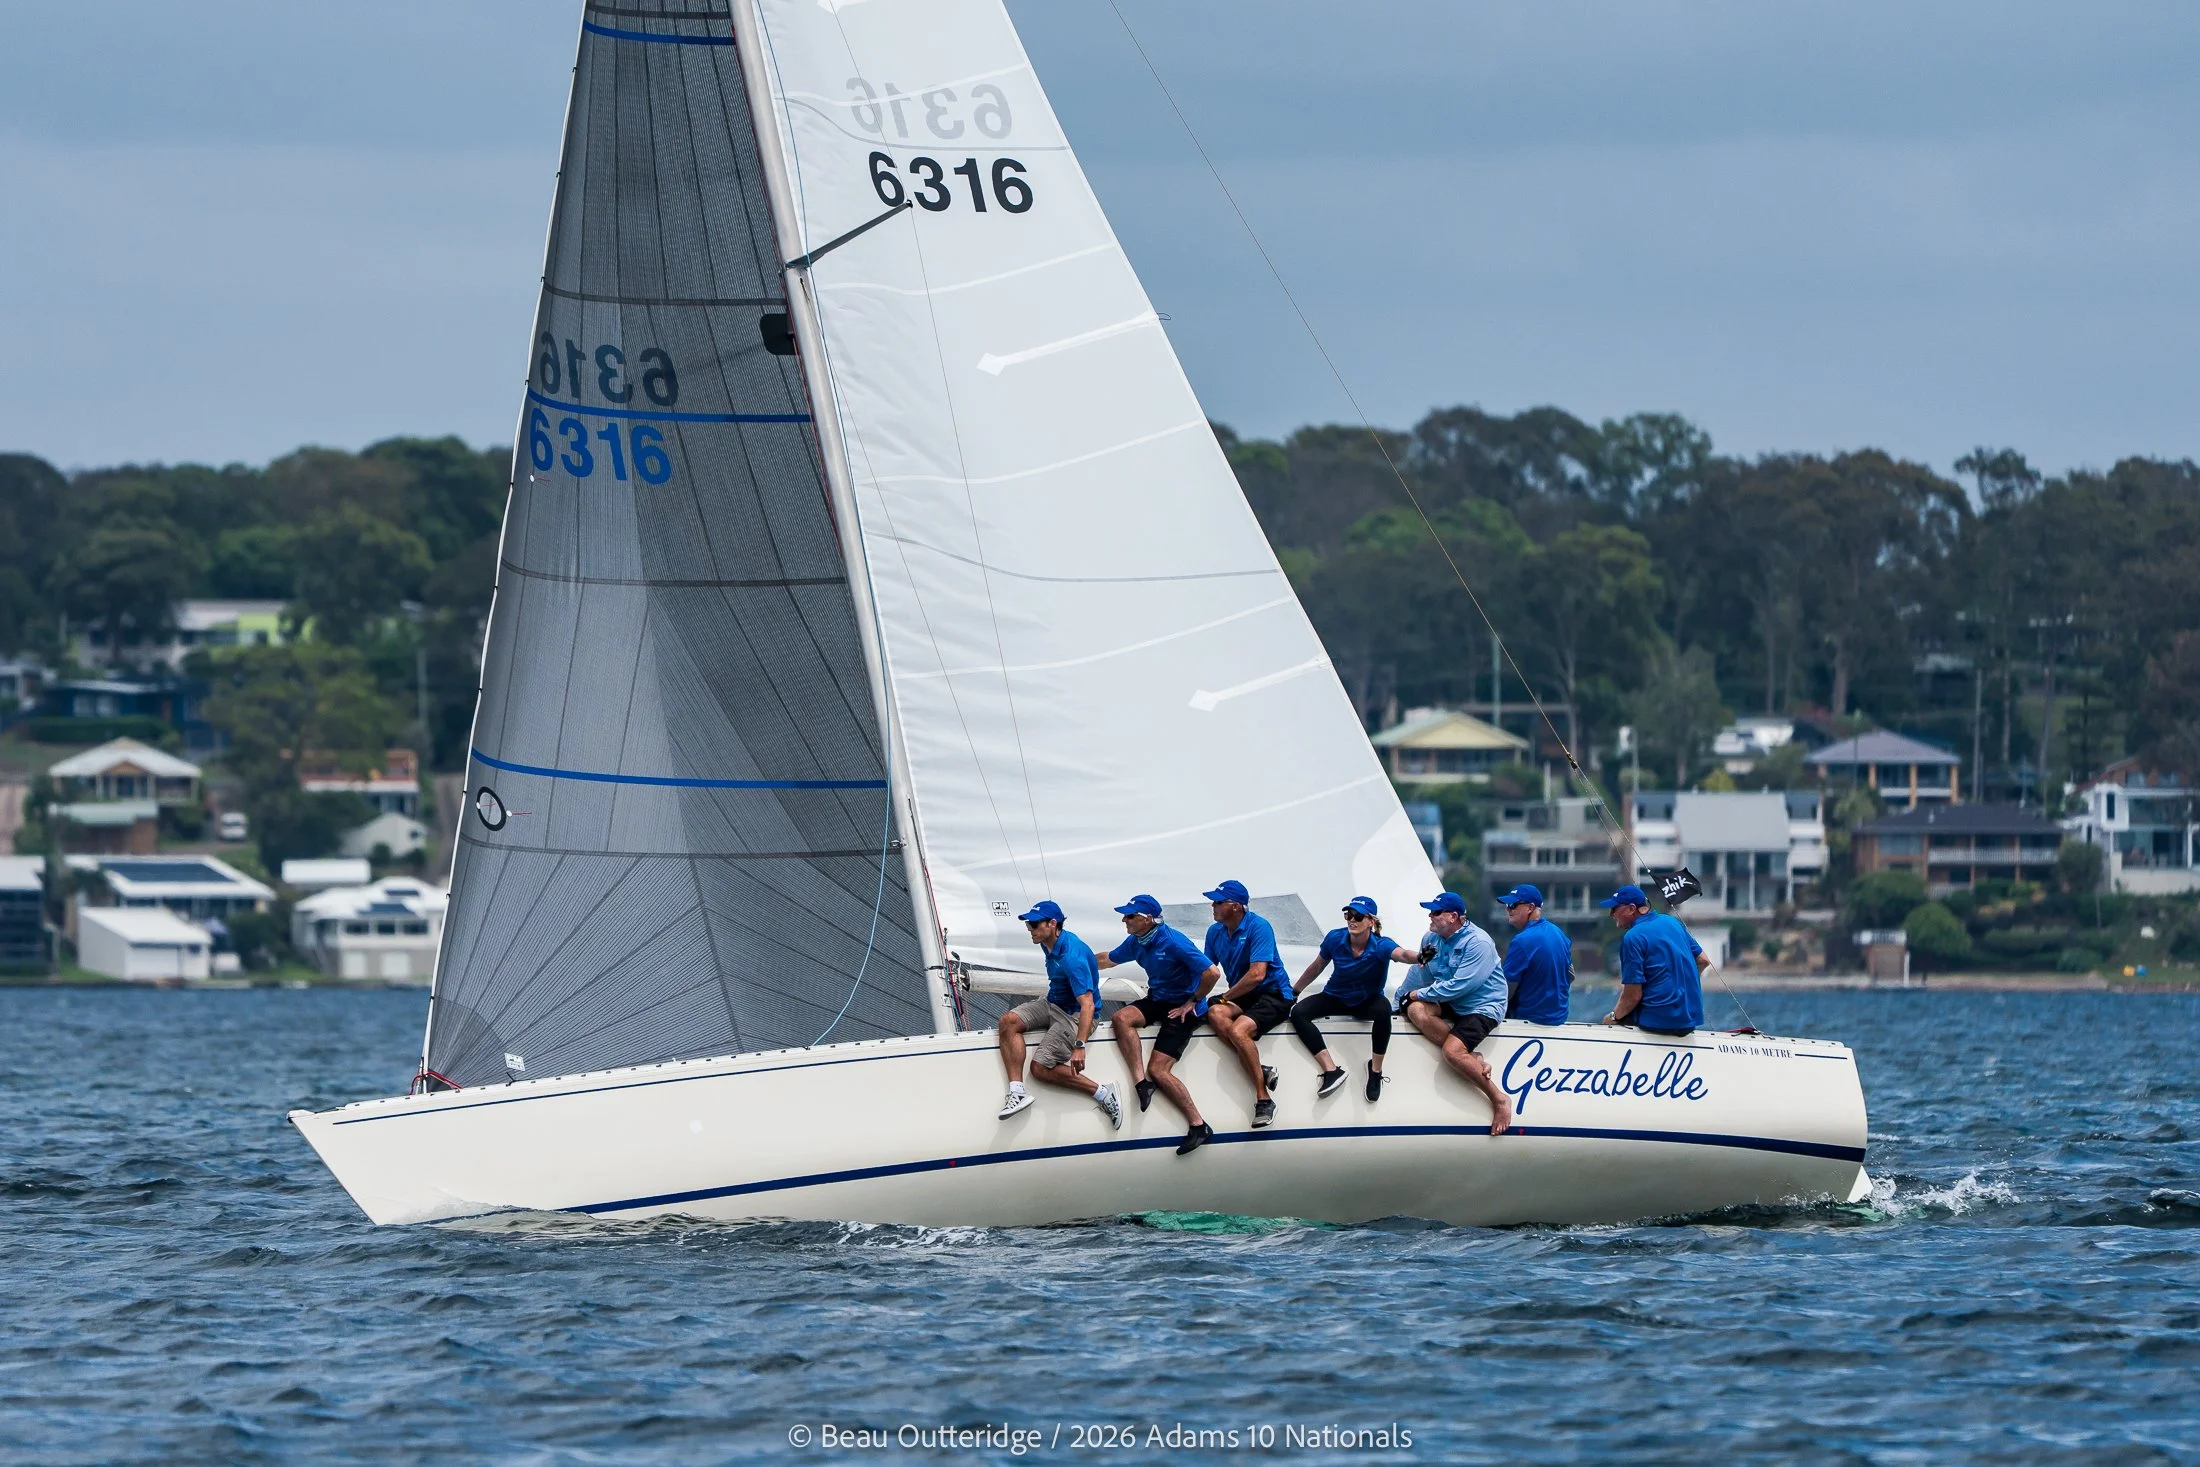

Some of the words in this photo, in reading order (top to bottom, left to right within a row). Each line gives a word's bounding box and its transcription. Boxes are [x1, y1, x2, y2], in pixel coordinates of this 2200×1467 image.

[868, 151, 1034, 214] 6316
[529, 407, 672, 485] 6316
[992, 901, 1009, 911] PM
[1501, 1038, 1709, 1115] Gezzabelle
[1717, 1044, 1748, 1055] ADAMS
[1750, 1046, 1760, 1056] 10
[1761, 1047, 1793, 1059] METRE
